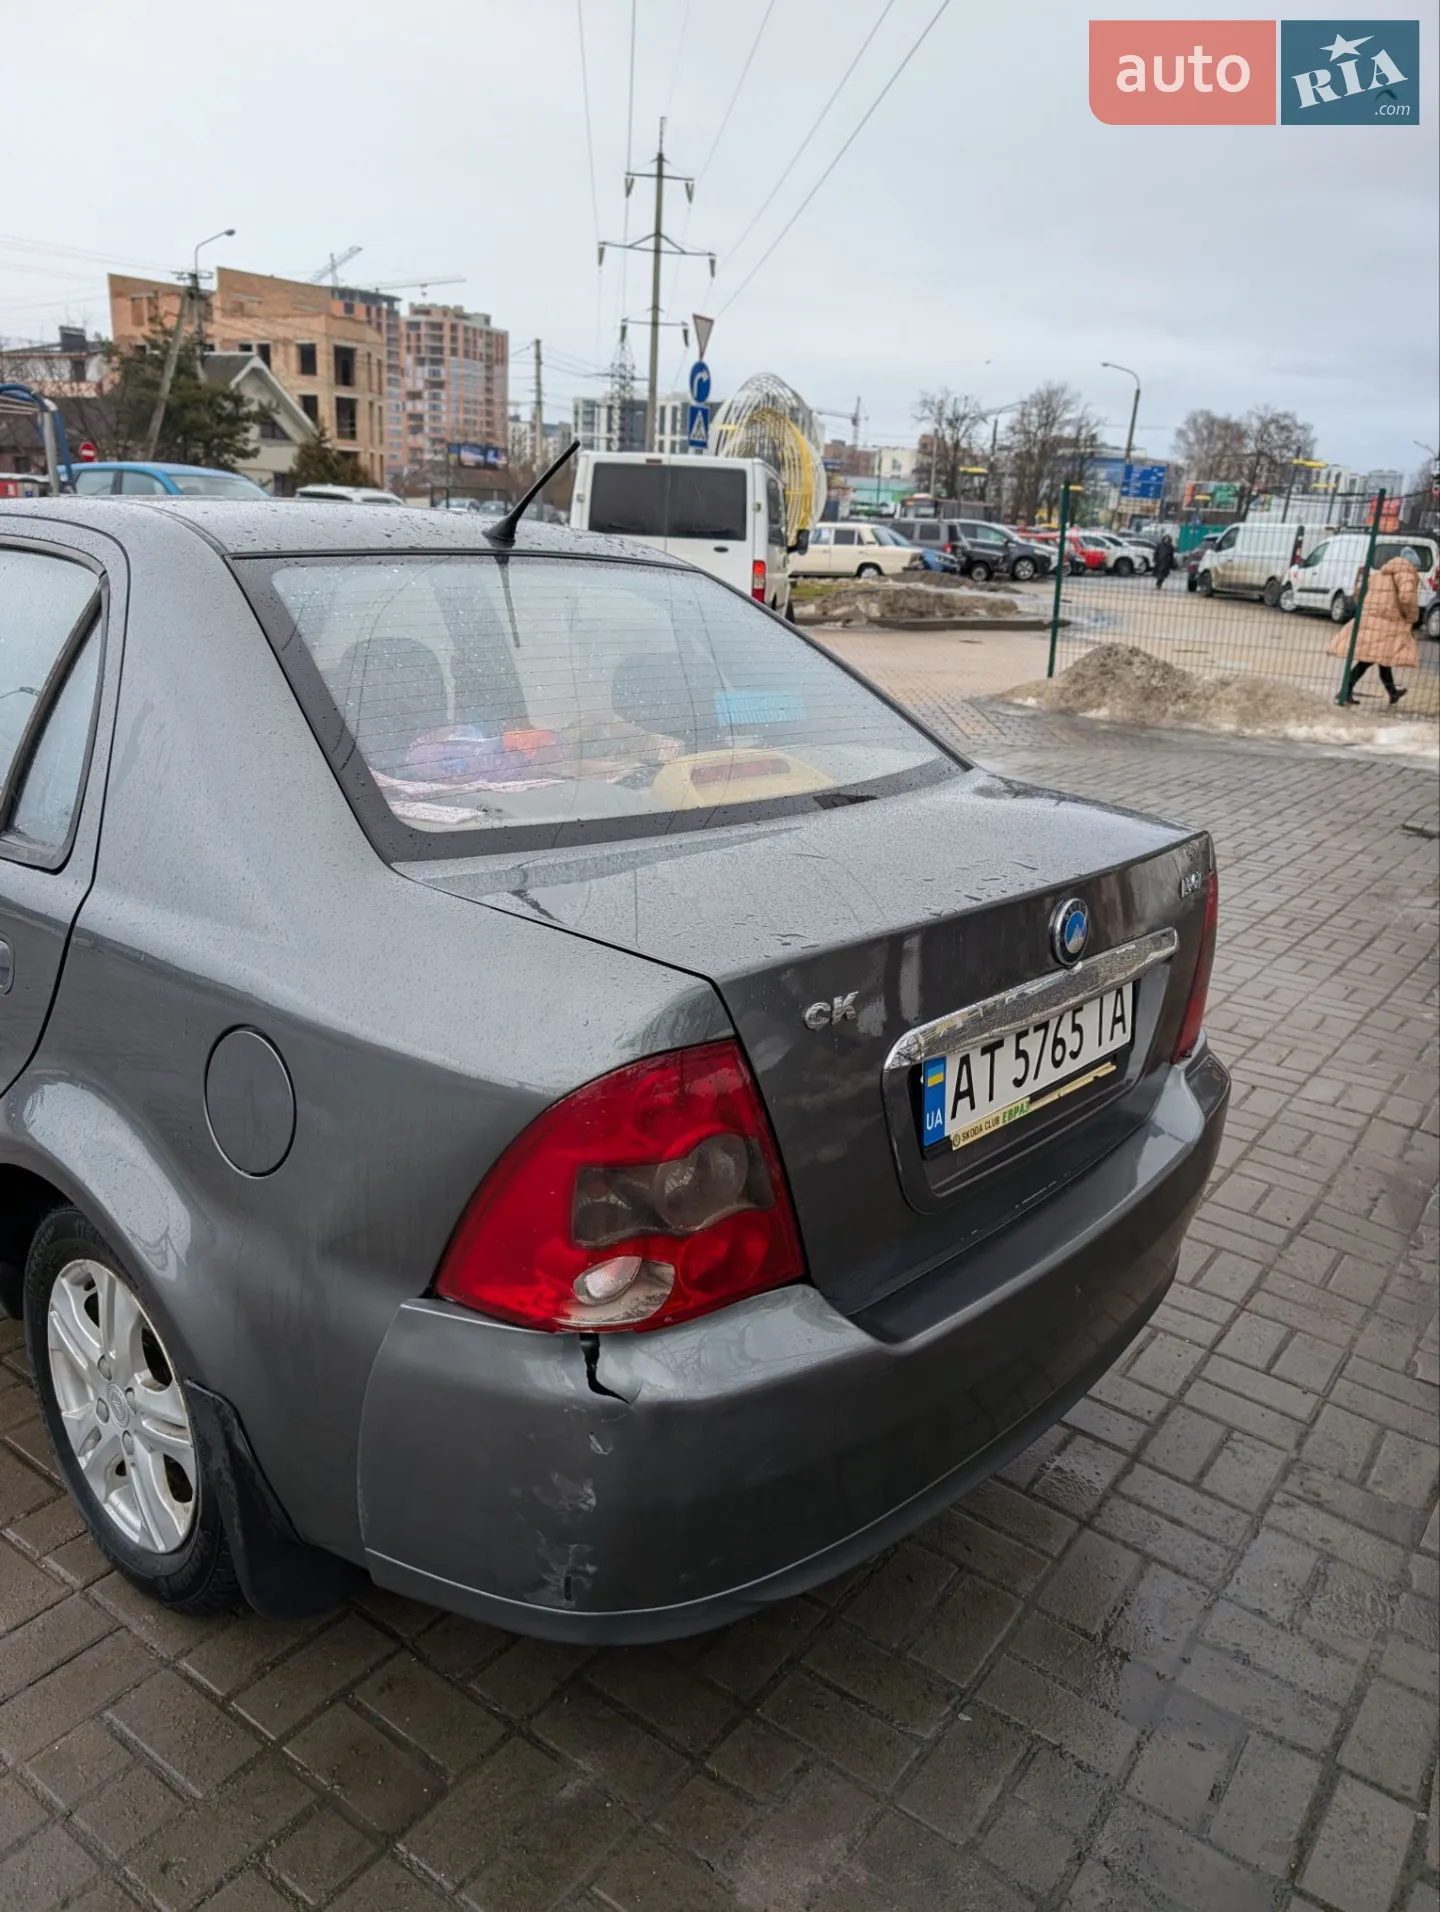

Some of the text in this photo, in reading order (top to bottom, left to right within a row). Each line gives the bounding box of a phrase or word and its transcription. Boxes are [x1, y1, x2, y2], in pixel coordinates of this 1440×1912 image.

[804, 990, 860, 1030] CK
[1012, 1006, 1084, 1088] 5765
[926, 1107, 943, 1130] UA
[961, 1124, 983, 1142] SKODA
[984, 1115, 1001, 1131] CLUB
